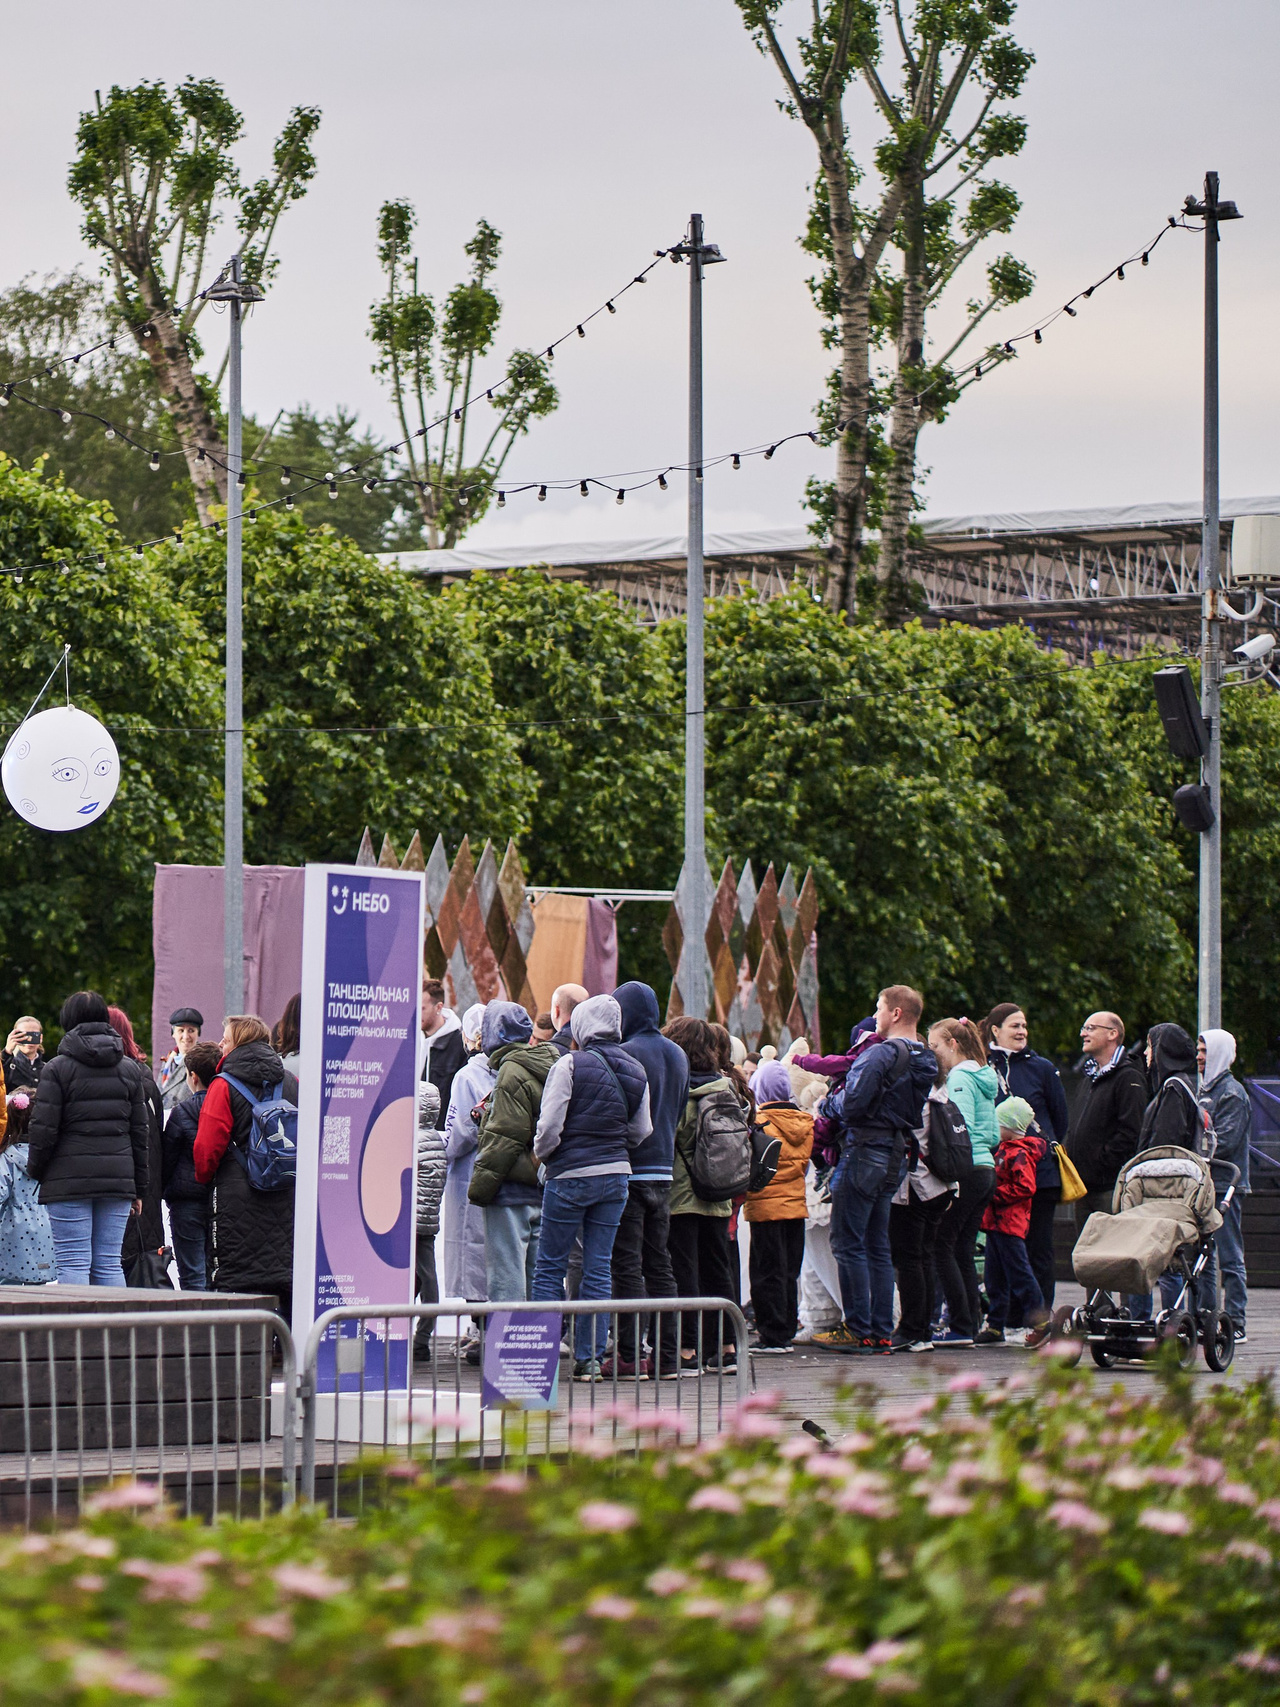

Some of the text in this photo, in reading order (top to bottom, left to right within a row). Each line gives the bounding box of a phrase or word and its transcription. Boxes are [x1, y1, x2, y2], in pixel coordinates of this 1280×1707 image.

[352, 891, 390, 914] НЕБО
[328, 983, 410, 1003] ТАНЦЕВАЛЬНАЯ
[327, 1002, 389, 1022] ПЛОЩАДКА
[327, 1025, 407, 1039] НА ЦЕНТРАЛЬНОЙ АЛЛЕЕ
[326, 1060, 384, 1073] КАРНАВАЛ, ЦИРК,
[325, 1073, 379, 1085] УЛИЧНЫЙ ТЕАТР
[325, 1088, 364, 1098] И ШЕСТВИЯ
[325, 1298, 338, 1306] ВХОД
[339, 1296, 369, 1305] СВОБОДНЫЙ
